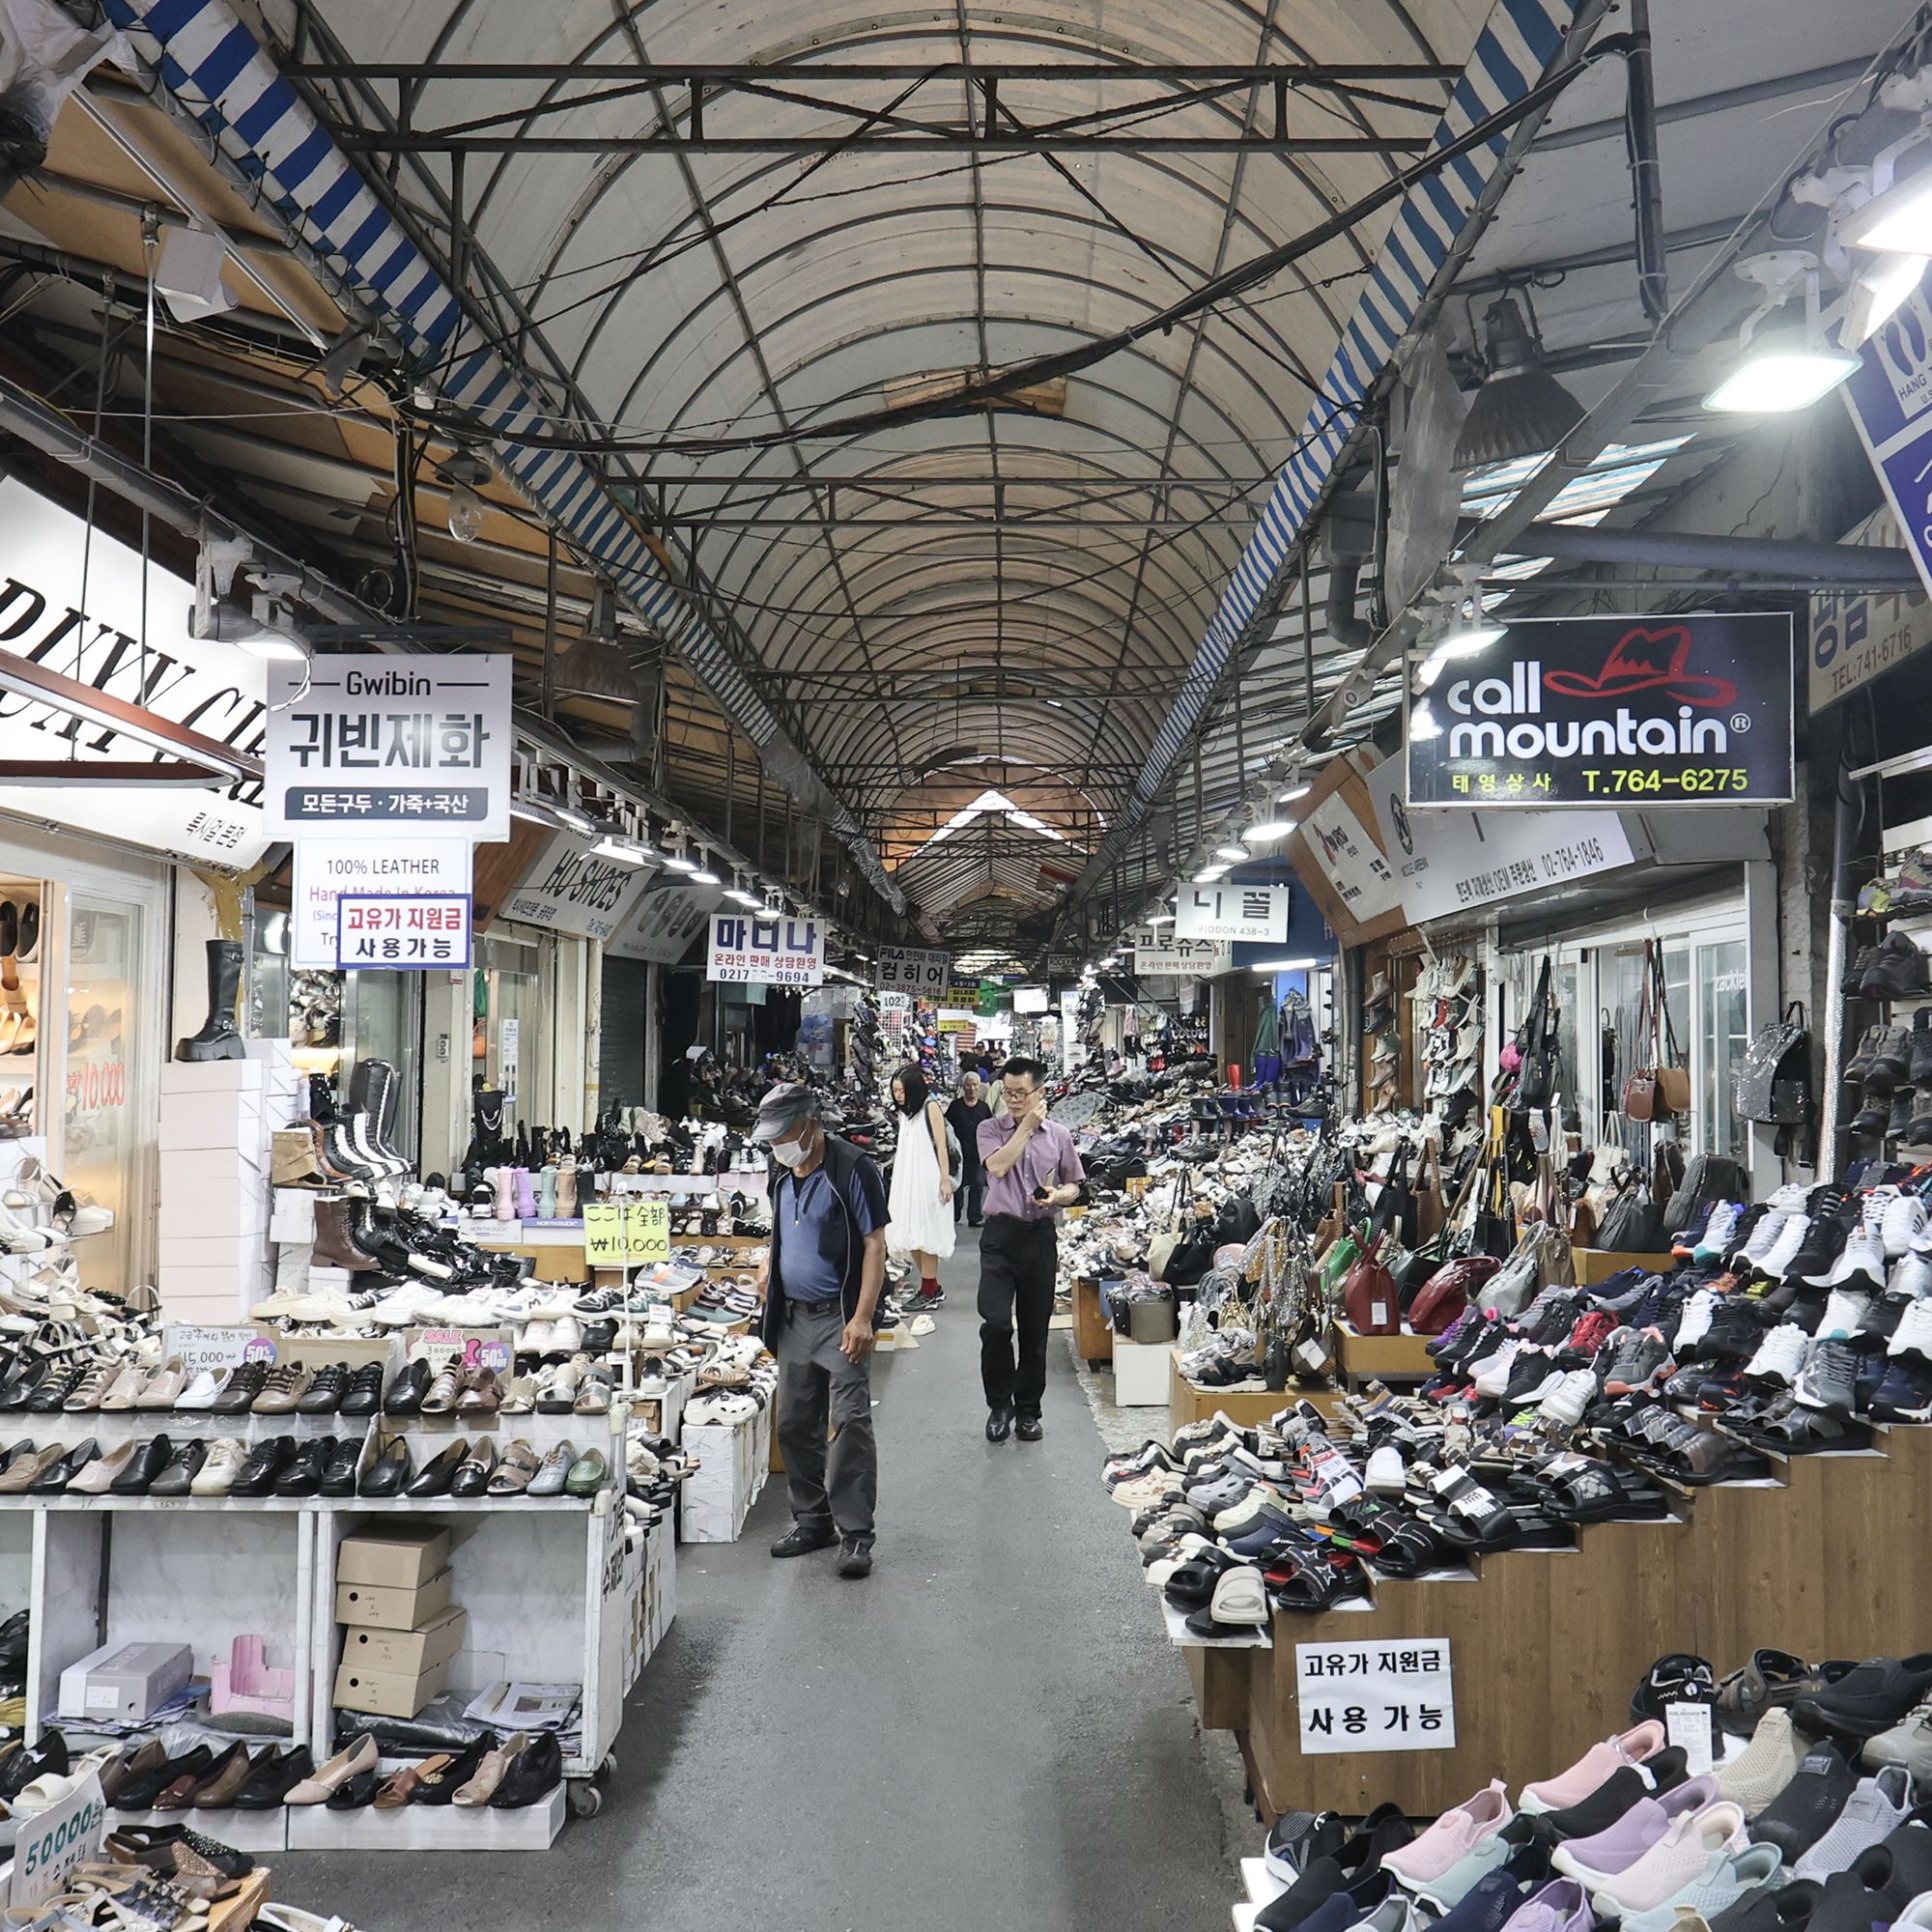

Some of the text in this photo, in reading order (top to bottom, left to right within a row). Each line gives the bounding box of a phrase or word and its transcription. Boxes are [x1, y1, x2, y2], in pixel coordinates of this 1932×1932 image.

[1898, 373, 1927, 402] HANG
[346, 670, 431, 696] Gwibin
[1447, 661, 1541, 715] call
[289, 713, 491, 768] 귀빈제화
[1582, 769, 1748, 794] T.764-6275
[300, 794, 469, 814] 모든구두 가죽+국산
[327, 859, 440, 874] 100% LEATHER
[1541, 838, 1605, 877] 02-764-1846
[569, 859, 633, 913] SHOES
[348, 907, 462, 930] 고유가 지원금
[714, 952, 816, 970] 온라인 판매 상담환영
[879, 947, 905, 960] FILA
[720, 968, 810, 982] 02)7-9694
[587, 1206, 666, 1227] ここは全部
[424, 1329, 462, 1344] SALE
[1304, 1650, 1440, 1676] 고유가 지원금
[1308, 1703, 1443, 1735] 사용 가능
